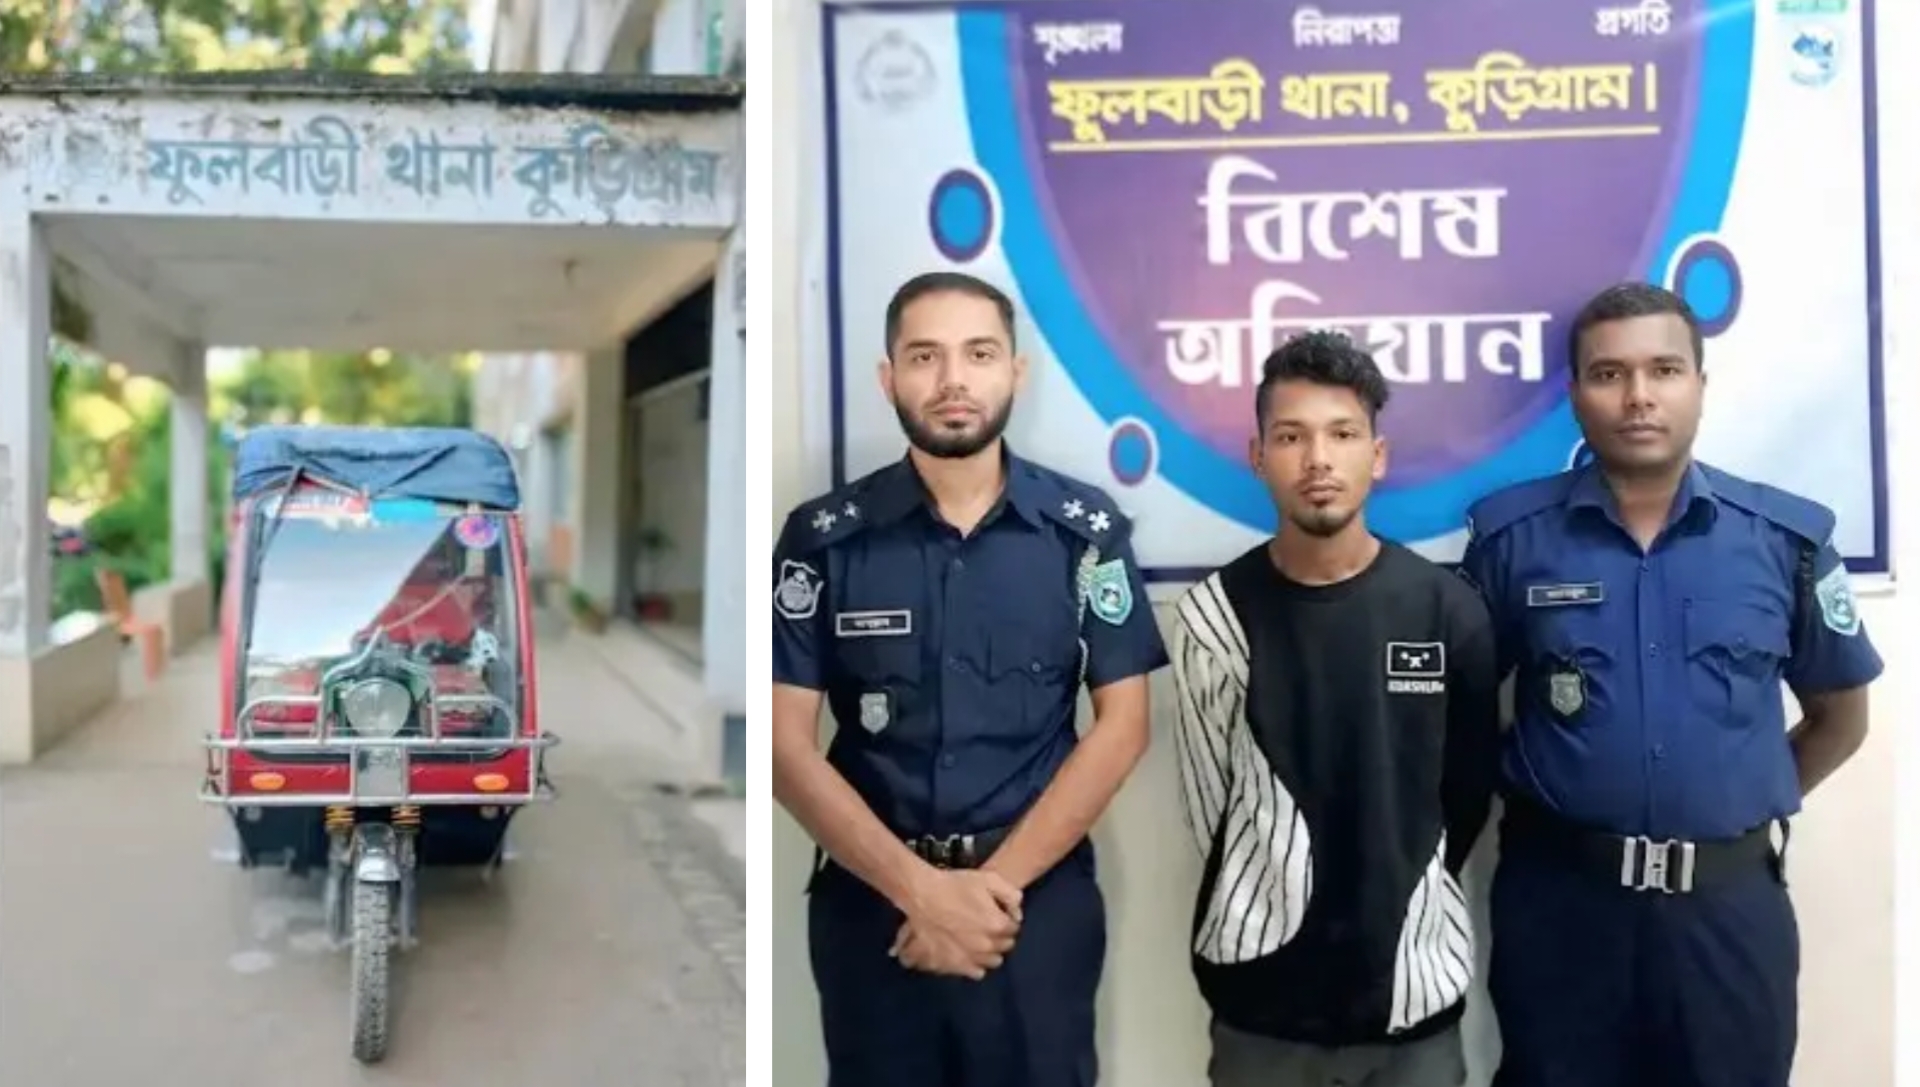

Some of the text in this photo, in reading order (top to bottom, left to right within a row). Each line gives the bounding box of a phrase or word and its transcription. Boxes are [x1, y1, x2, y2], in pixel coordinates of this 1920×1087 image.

[1596, 0, 1672, 35] প্রগতি
[1048, 59, 1264, 142] ফুলবাড়ী
[1281, 72, 1409, 124] থানা,
[146, 114, 359, 211] ফুলবাড়ী
[386, 127, 499, 198] থানা
[1197, 155, 1508, 264] বিশেষ
